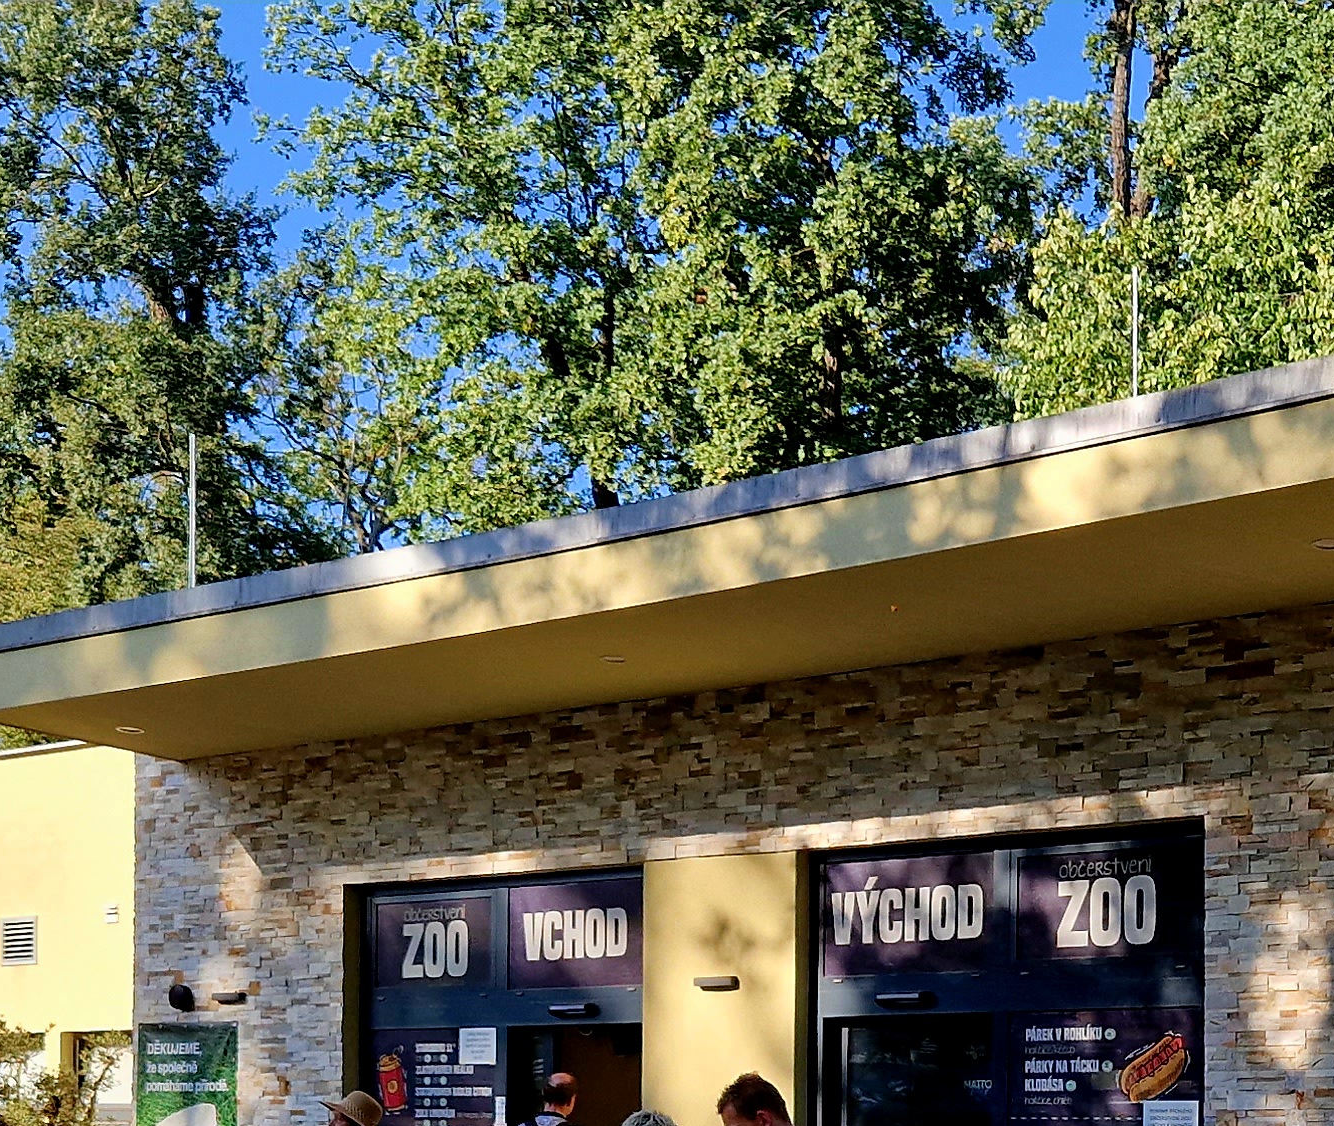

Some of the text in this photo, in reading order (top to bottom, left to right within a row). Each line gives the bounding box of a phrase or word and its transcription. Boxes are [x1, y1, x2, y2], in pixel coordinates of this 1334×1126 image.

[523, 907, 629, 962] VCHOD
[831, 876, 985, 946] VÝCHOD
[1056, 874, 1157, 949] ZOO
[402, 920, 469, 979] ZOO
[146, 1040, 203, 1057] DĚKUJEME,
[158, 1060, 198, 1077] společně
